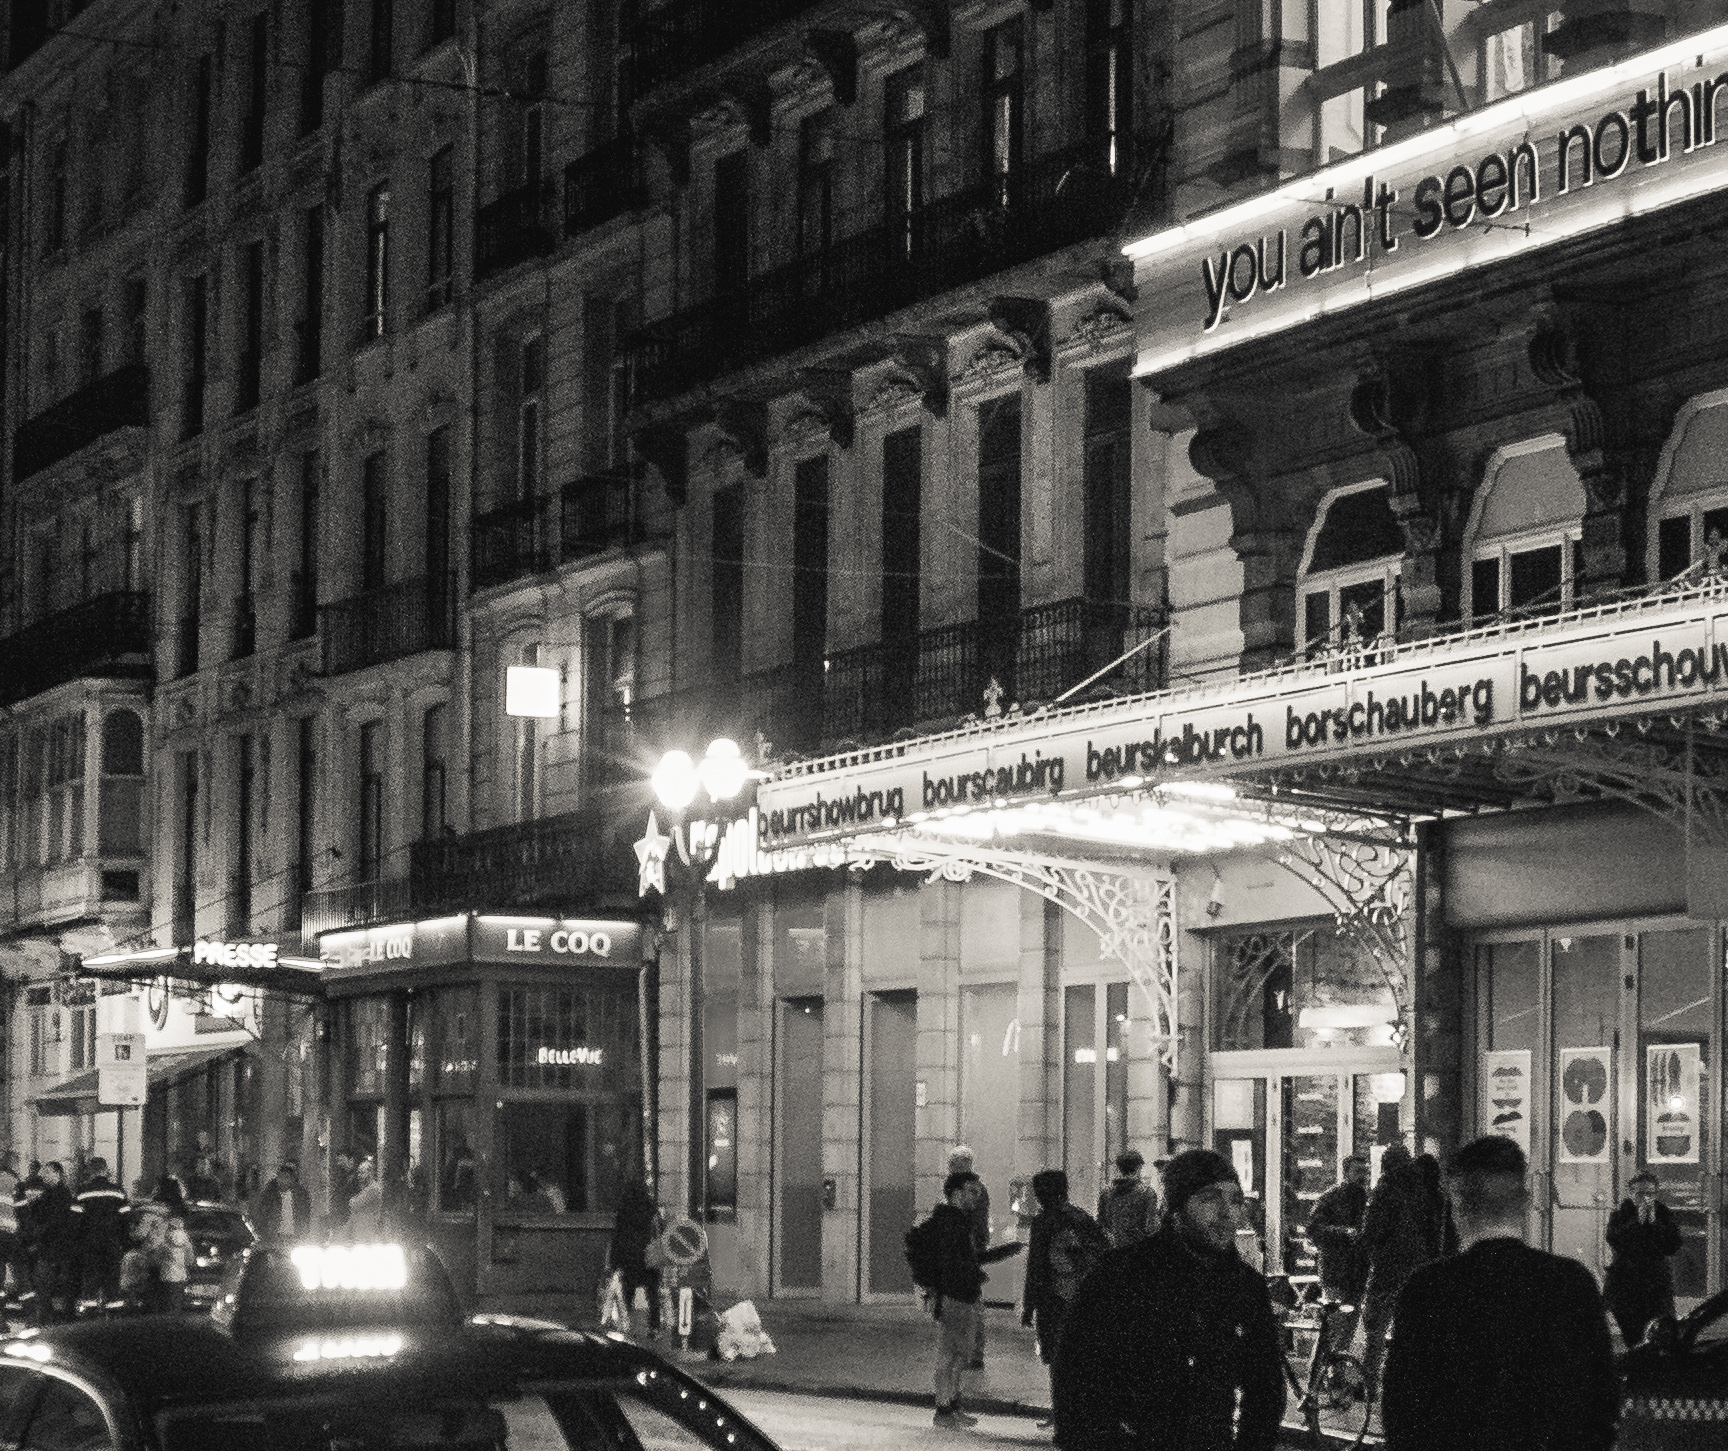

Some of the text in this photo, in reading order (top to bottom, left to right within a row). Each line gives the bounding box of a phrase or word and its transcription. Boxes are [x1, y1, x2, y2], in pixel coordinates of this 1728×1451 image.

[1202, 228, 1286, 333] you
[1299, 176, 1399, 280] ain't
[1413, 140, 1540, 242] seen
[1284, 678, 1494, 751] borschauberg
[193, 940, 279, 969] PRESSE
[506, 928, 612, 958] LE COQ
